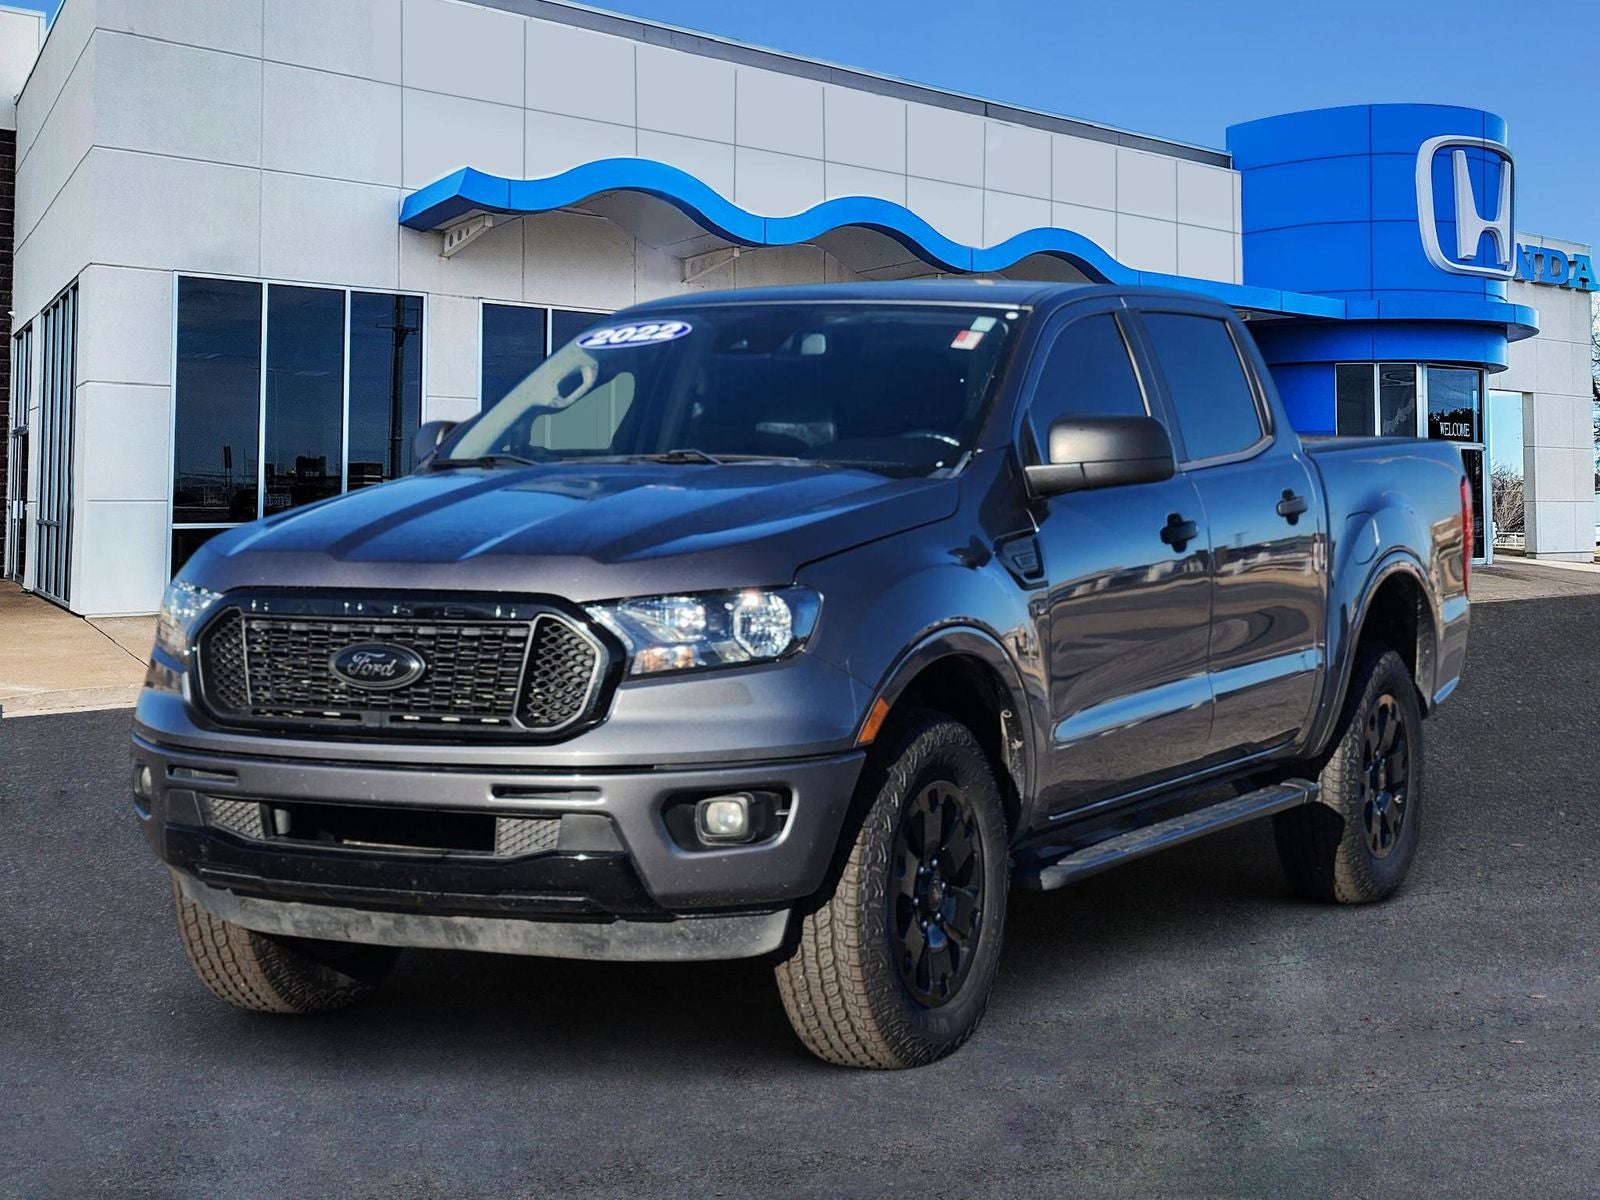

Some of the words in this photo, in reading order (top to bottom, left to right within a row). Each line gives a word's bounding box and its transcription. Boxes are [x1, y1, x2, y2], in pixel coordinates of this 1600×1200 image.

[1516, 243, 1600, 291] NDA
[583, 322, 683, 346] 2022
[1440, 421, 1470, 437] WELCOME
[347, 651, 397, 676] Ford
